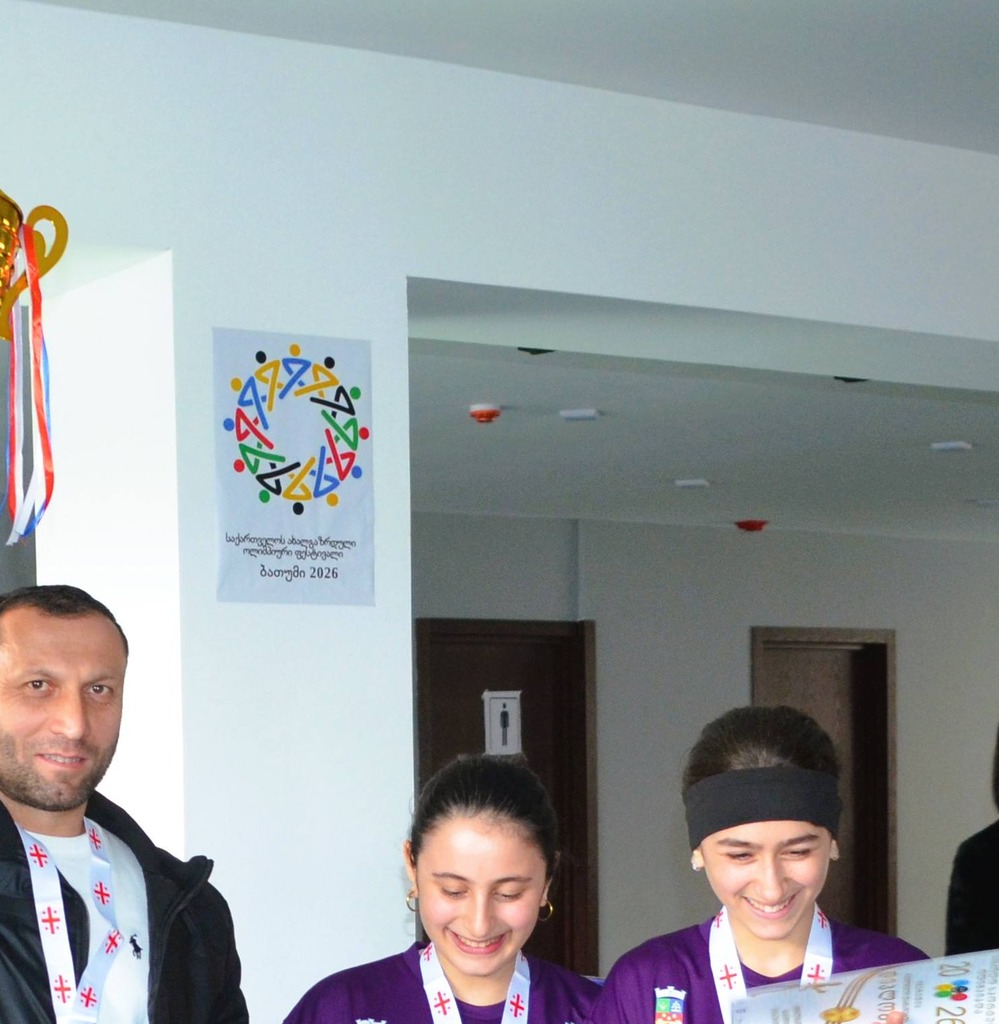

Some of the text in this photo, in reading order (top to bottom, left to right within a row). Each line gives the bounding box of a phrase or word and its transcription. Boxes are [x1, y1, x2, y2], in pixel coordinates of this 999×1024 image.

[225, 532, 357, 550] საქართველოს ახალგაზრდული
[242, 546, 344, 561] ოლიმპიური ფესტივალი
[260, 564, 339, 582] ბათუმი 2026
